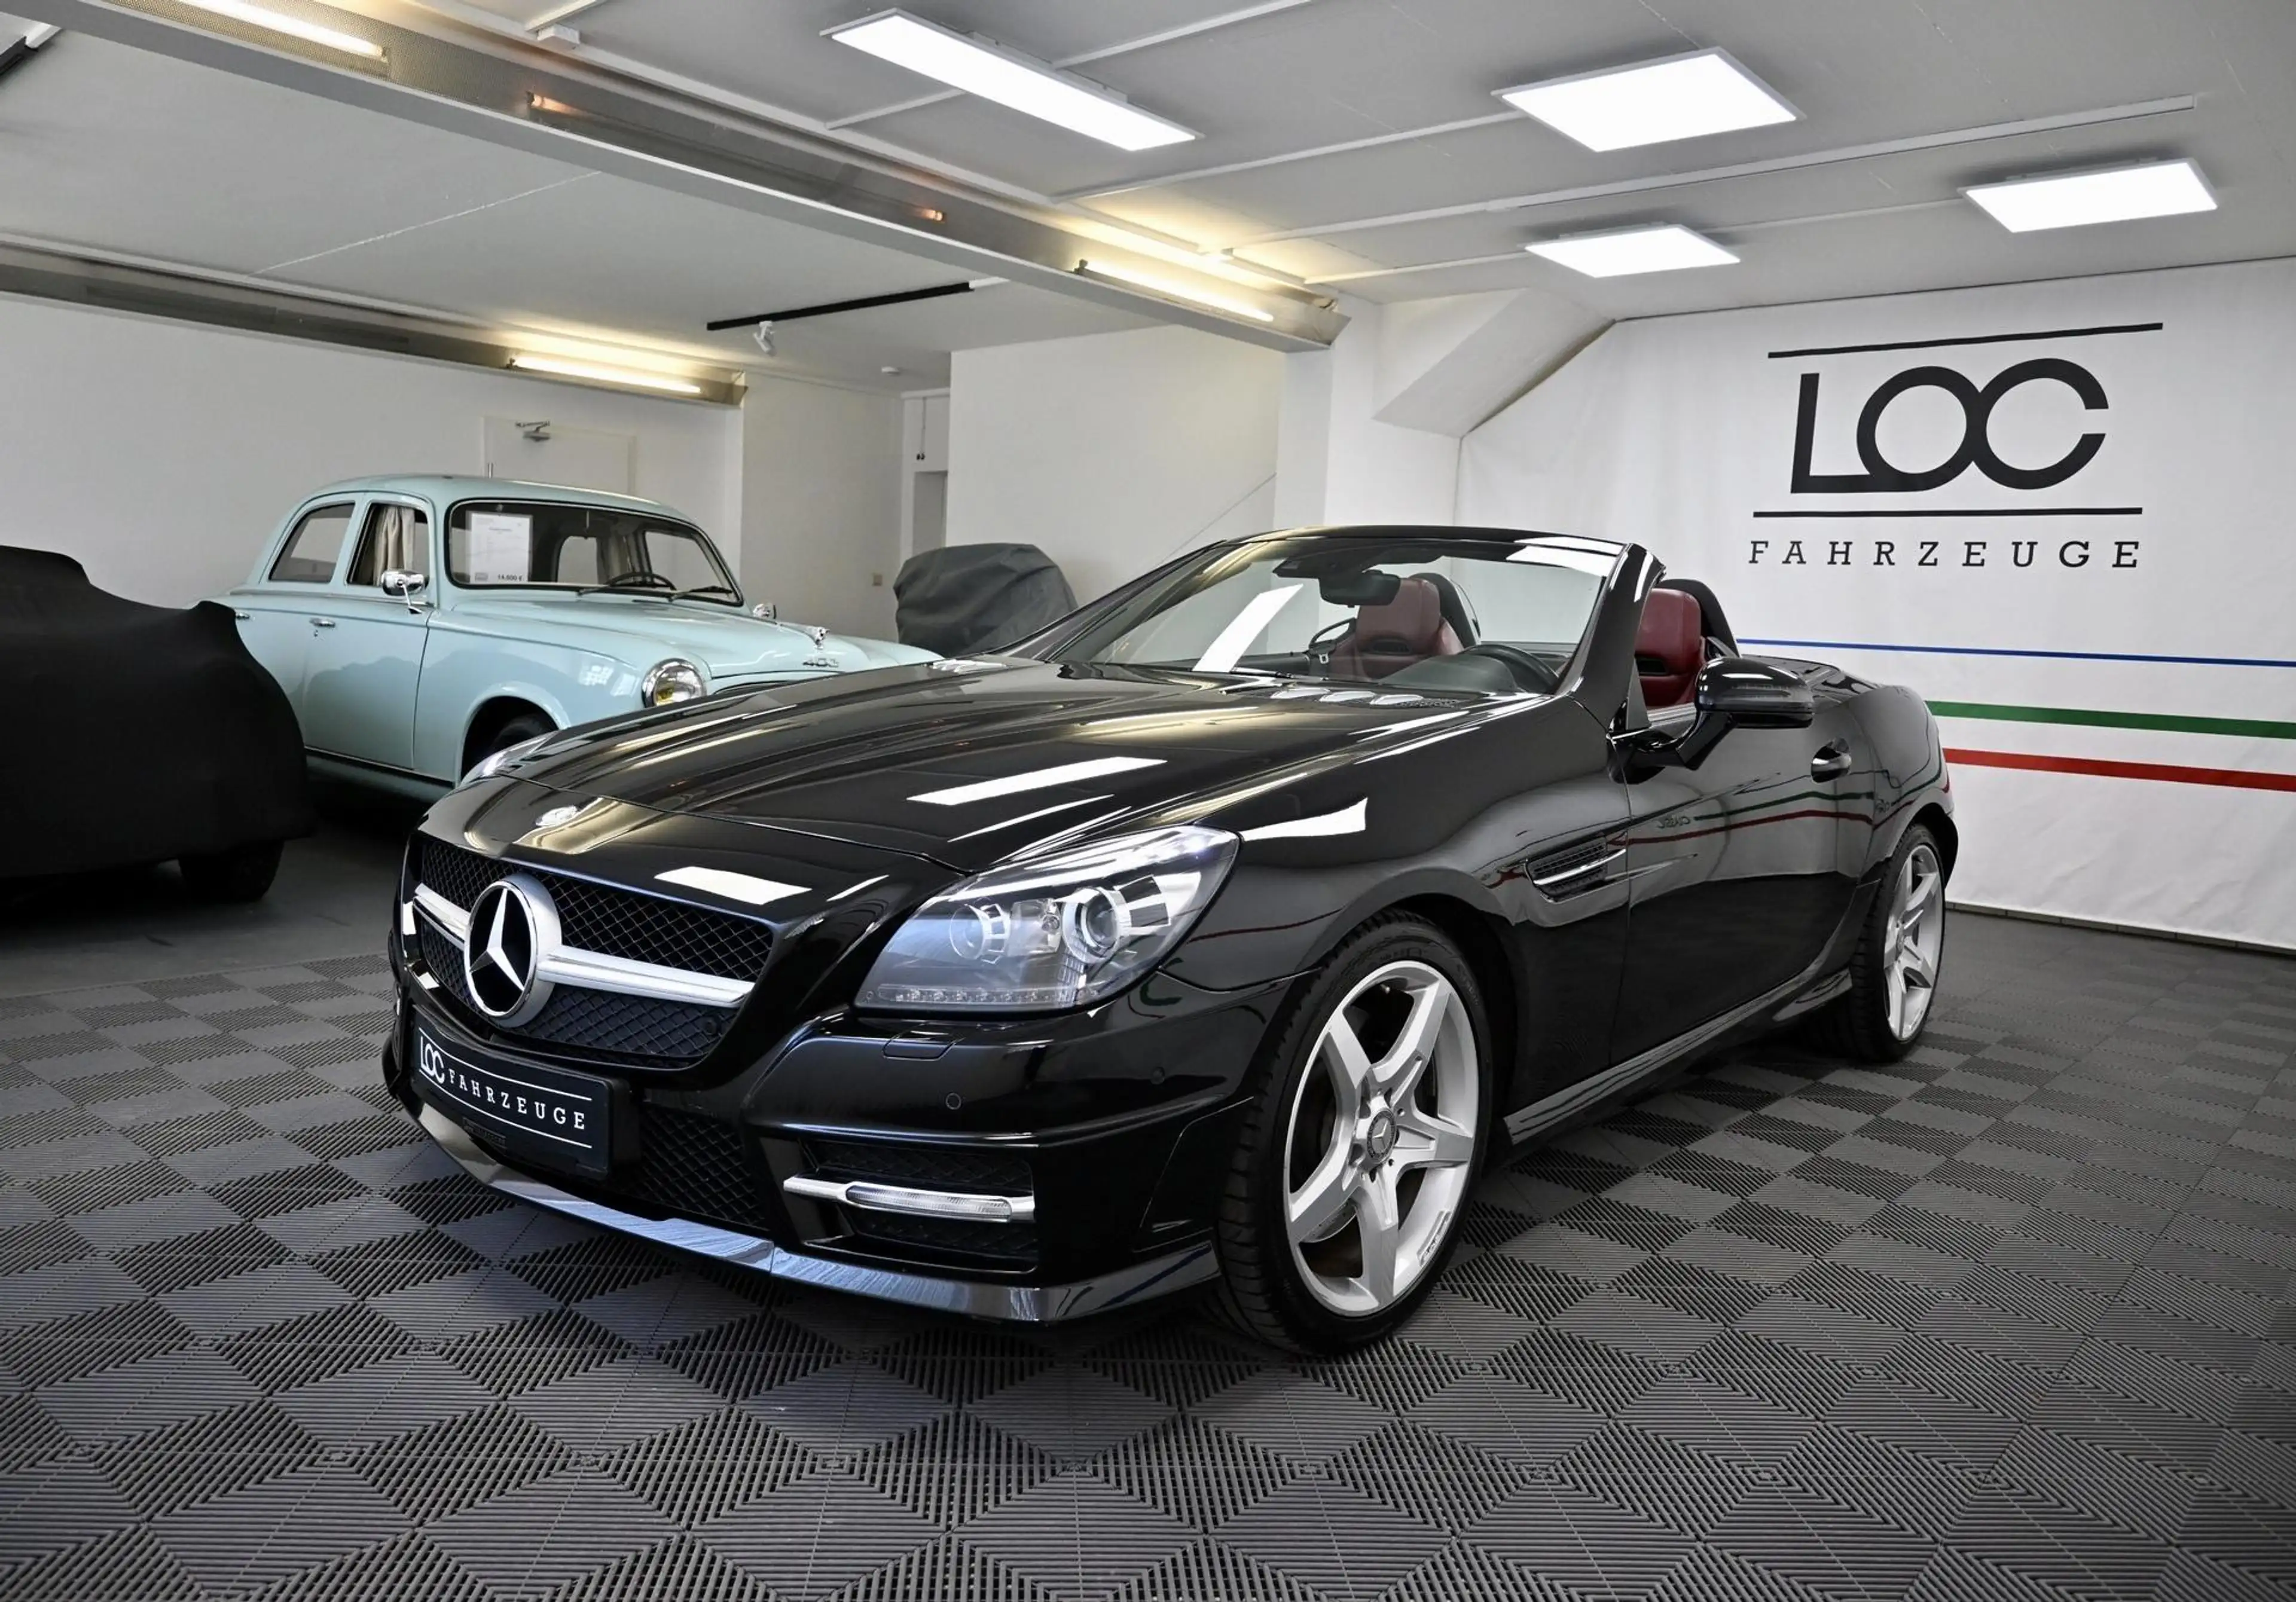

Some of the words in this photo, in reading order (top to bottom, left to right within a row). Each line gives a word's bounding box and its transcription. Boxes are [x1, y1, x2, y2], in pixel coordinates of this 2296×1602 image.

[1790, 357, 2109, 493] LOC
[1748, 540, 2139, 568] FAHRZEUGE
[420, 1035, 445, 1084] LOC
[448, 1068, 585, 1130] FAHRZEUGE
